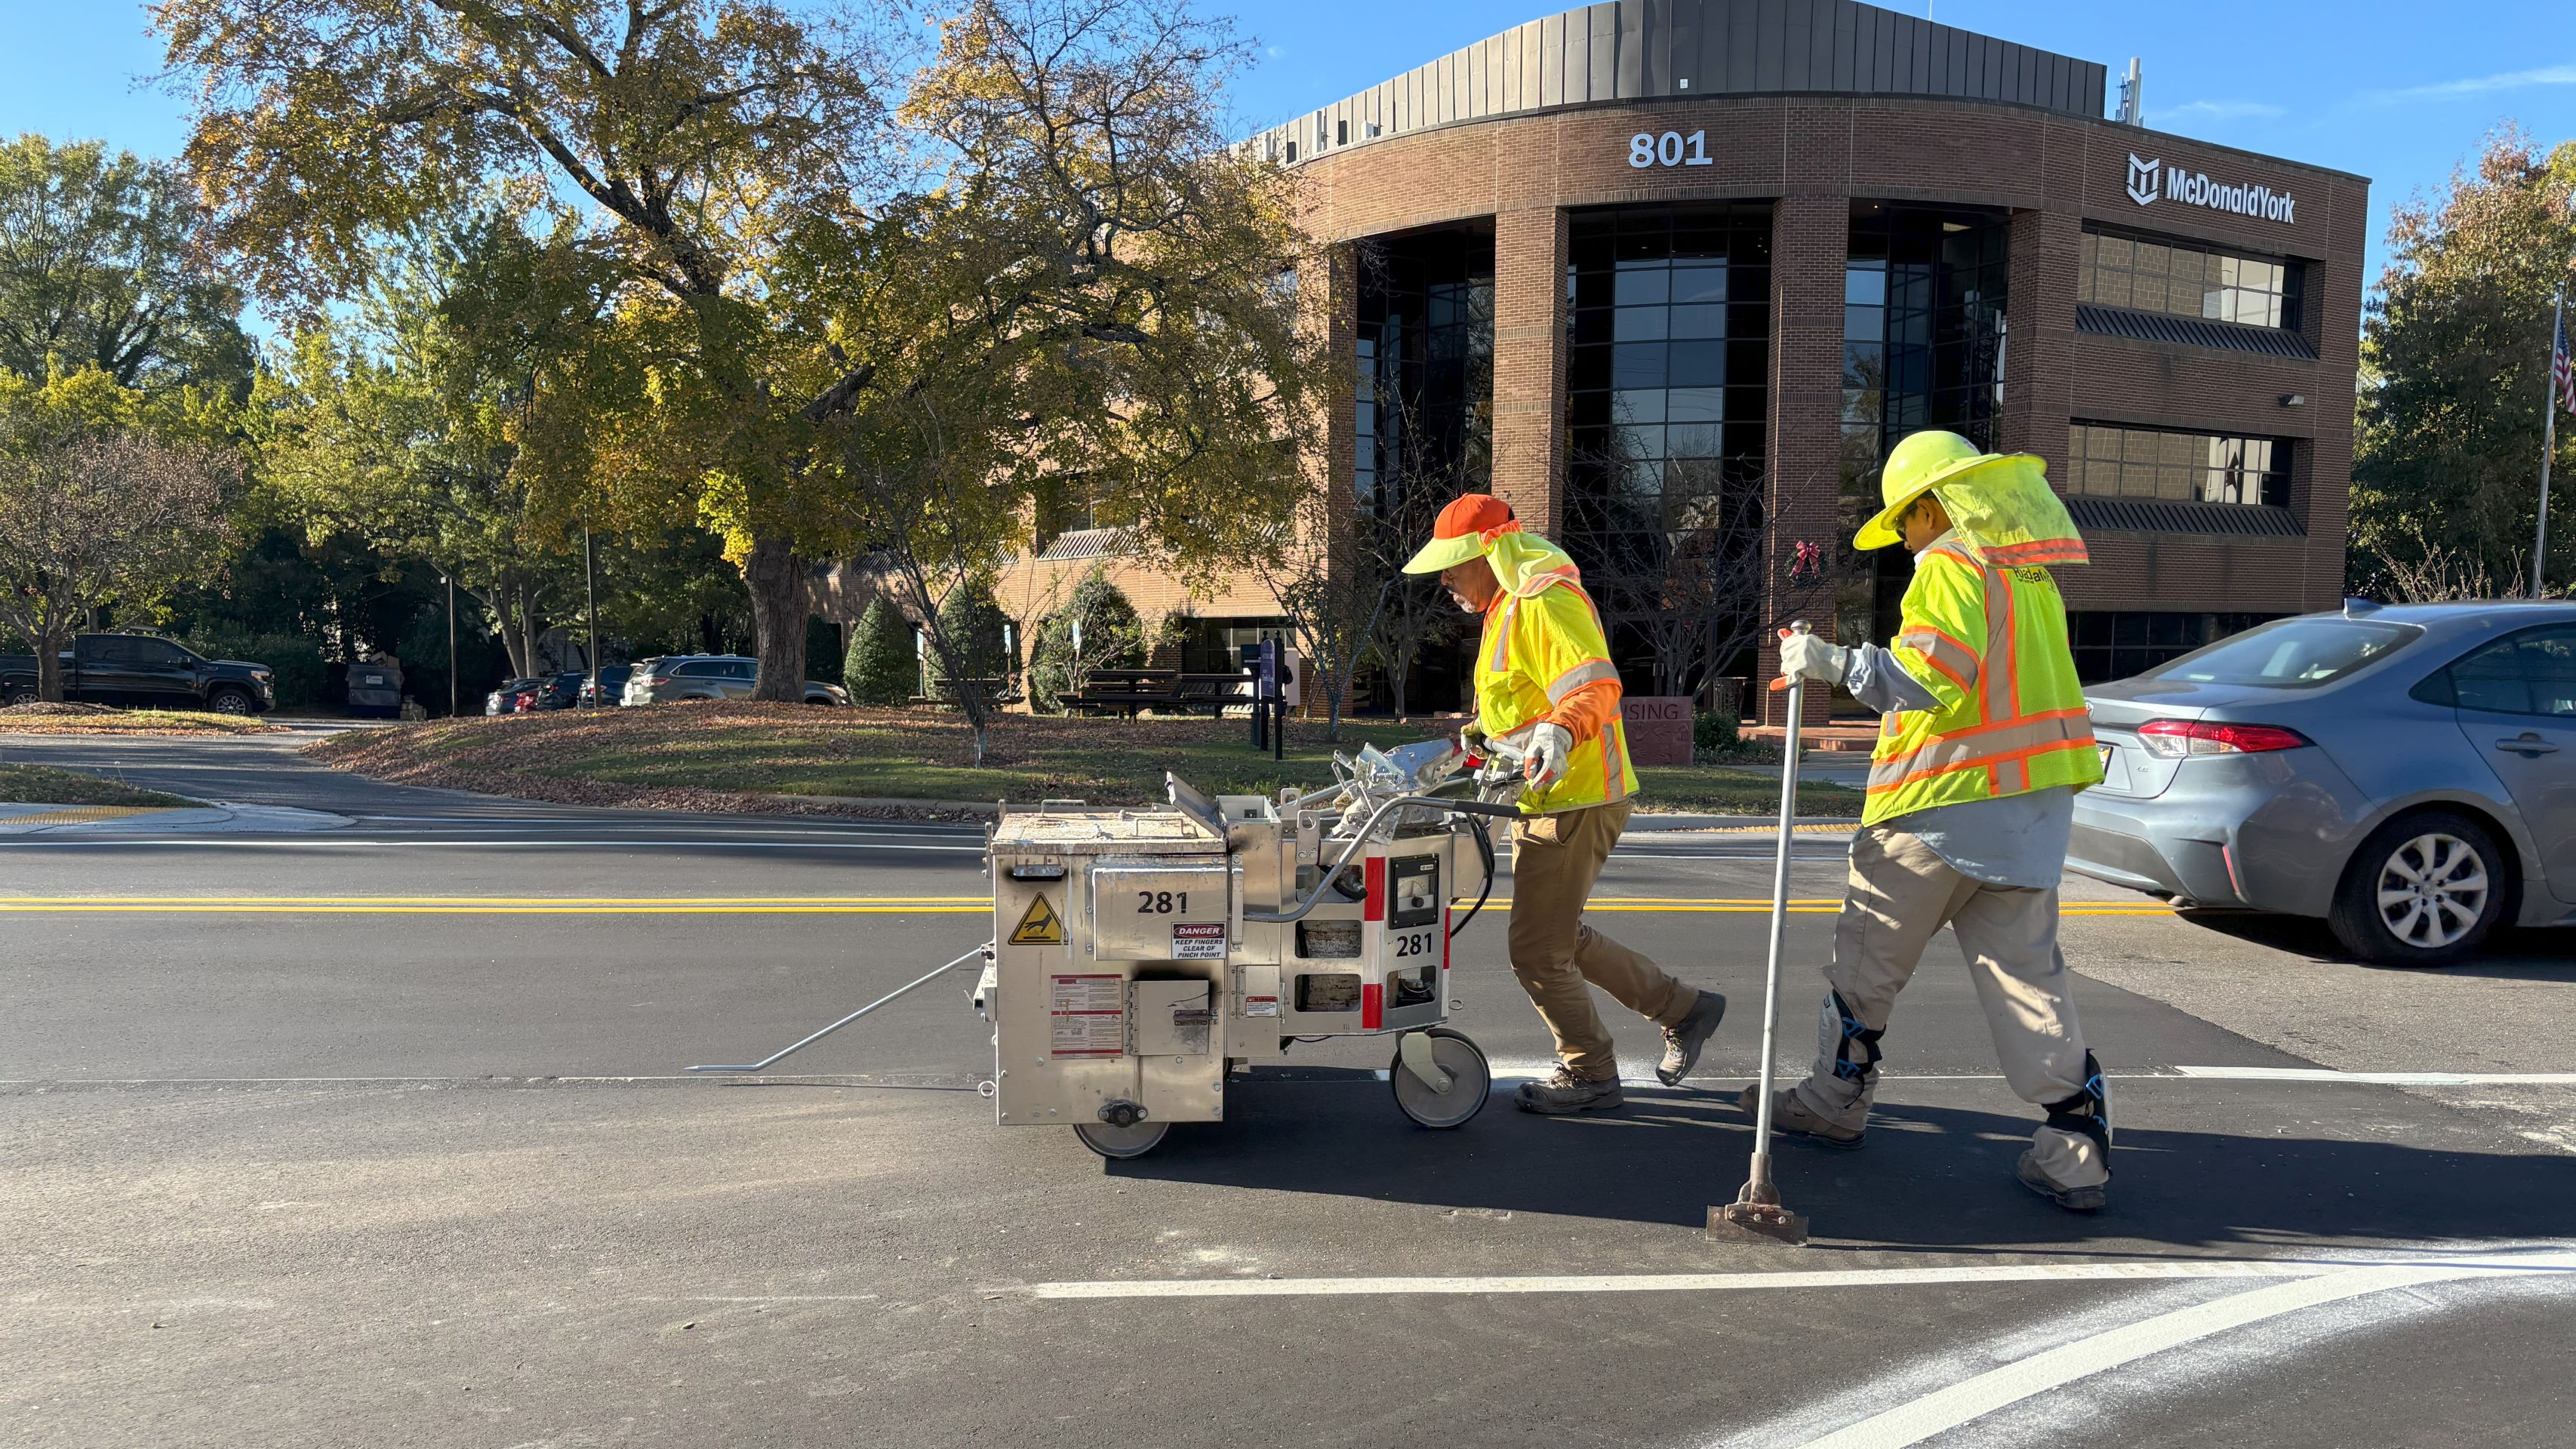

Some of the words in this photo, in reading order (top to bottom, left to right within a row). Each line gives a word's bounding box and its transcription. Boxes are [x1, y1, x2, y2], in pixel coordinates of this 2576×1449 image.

[1629, 130, 1713, 168] 801
[2165, 167, 2296, 224] McDonaldYork
[1137, 891, 1187, 914] 281
[1396, 932, 1432, 958] 281
